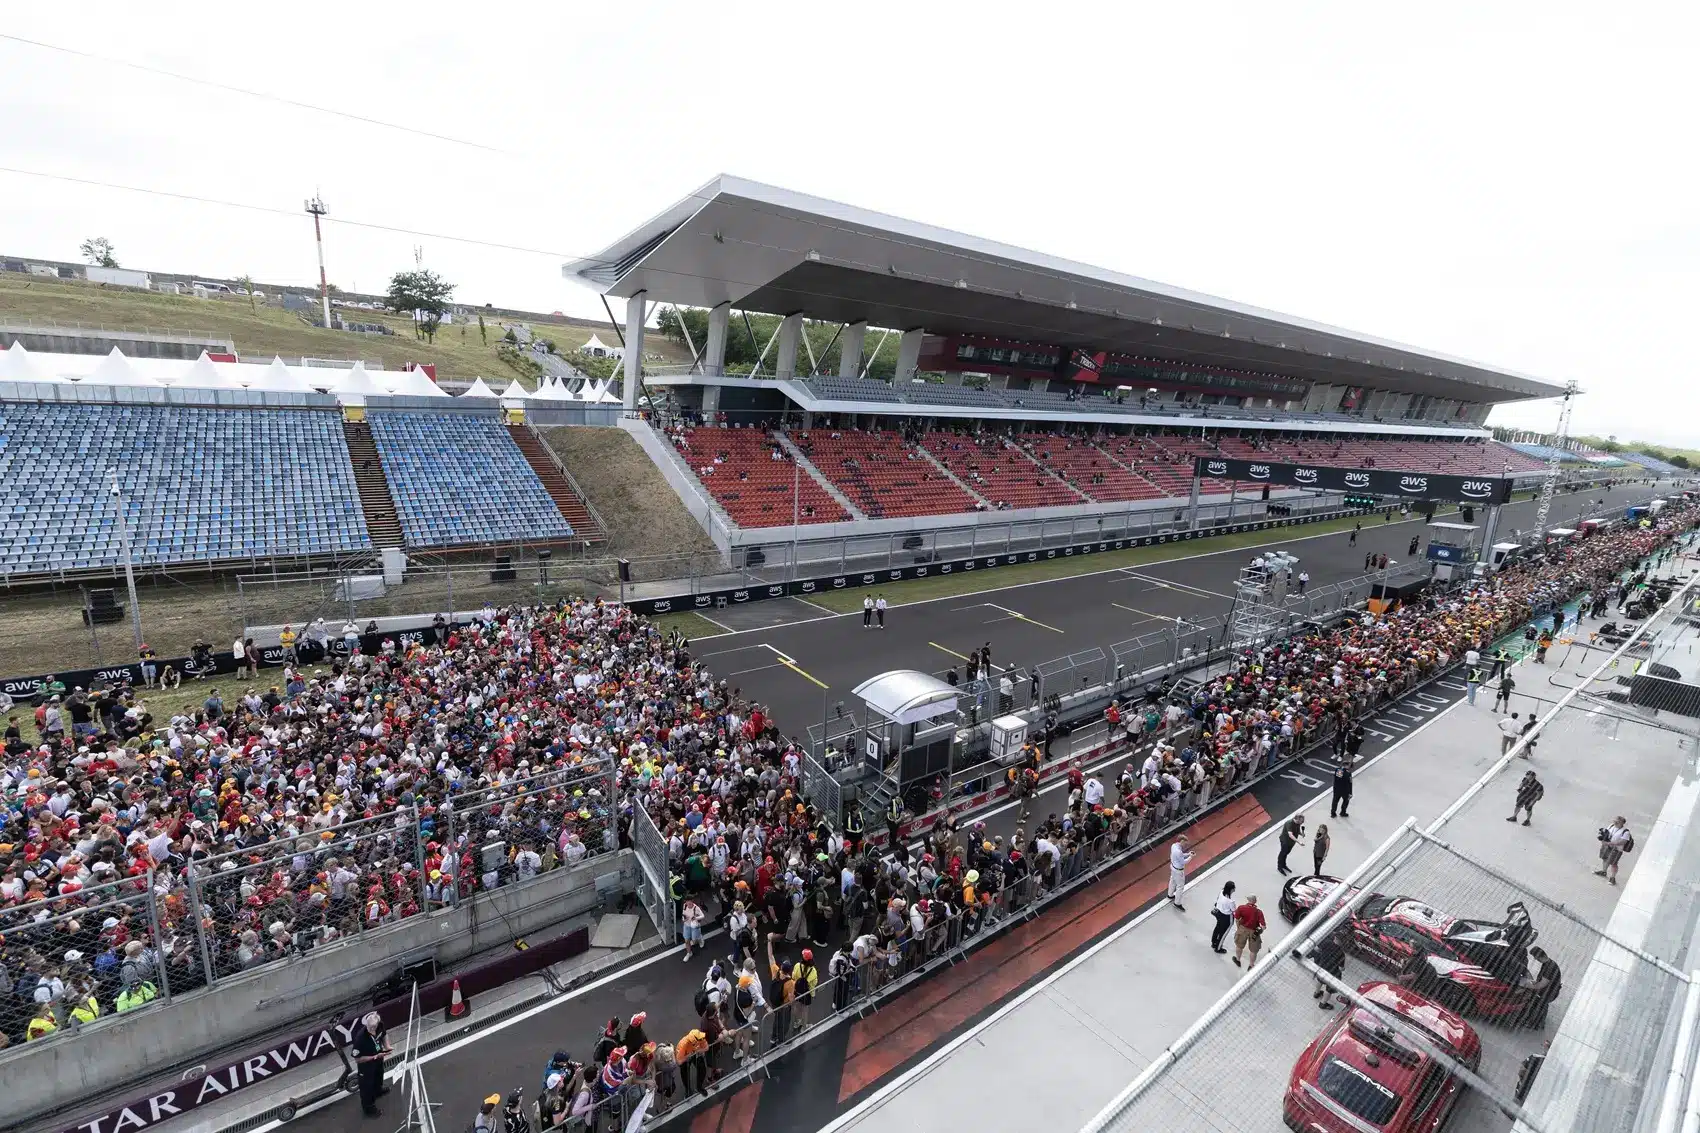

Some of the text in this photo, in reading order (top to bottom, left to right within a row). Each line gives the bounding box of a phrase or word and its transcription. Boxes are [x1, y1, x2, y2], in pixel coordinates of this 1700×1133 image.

[1208, 461, 1227, 470] aws
[1249, 465, 1270, 474] aws
[1295, 468, 1318, 478] aws
[1345, 472, 1370, 482] aws
[1400, 476, 1428, 486] aws
[1462, 480, 1492, 491] aws
[98, 668, 131, 680] aws
[5, 679, 42, 692] aws
[869, 742, 875, 754] 0
[1357, 941, 1403, 969] CROWDSTRIK
[76, 1090, 182, 1133] TAR
